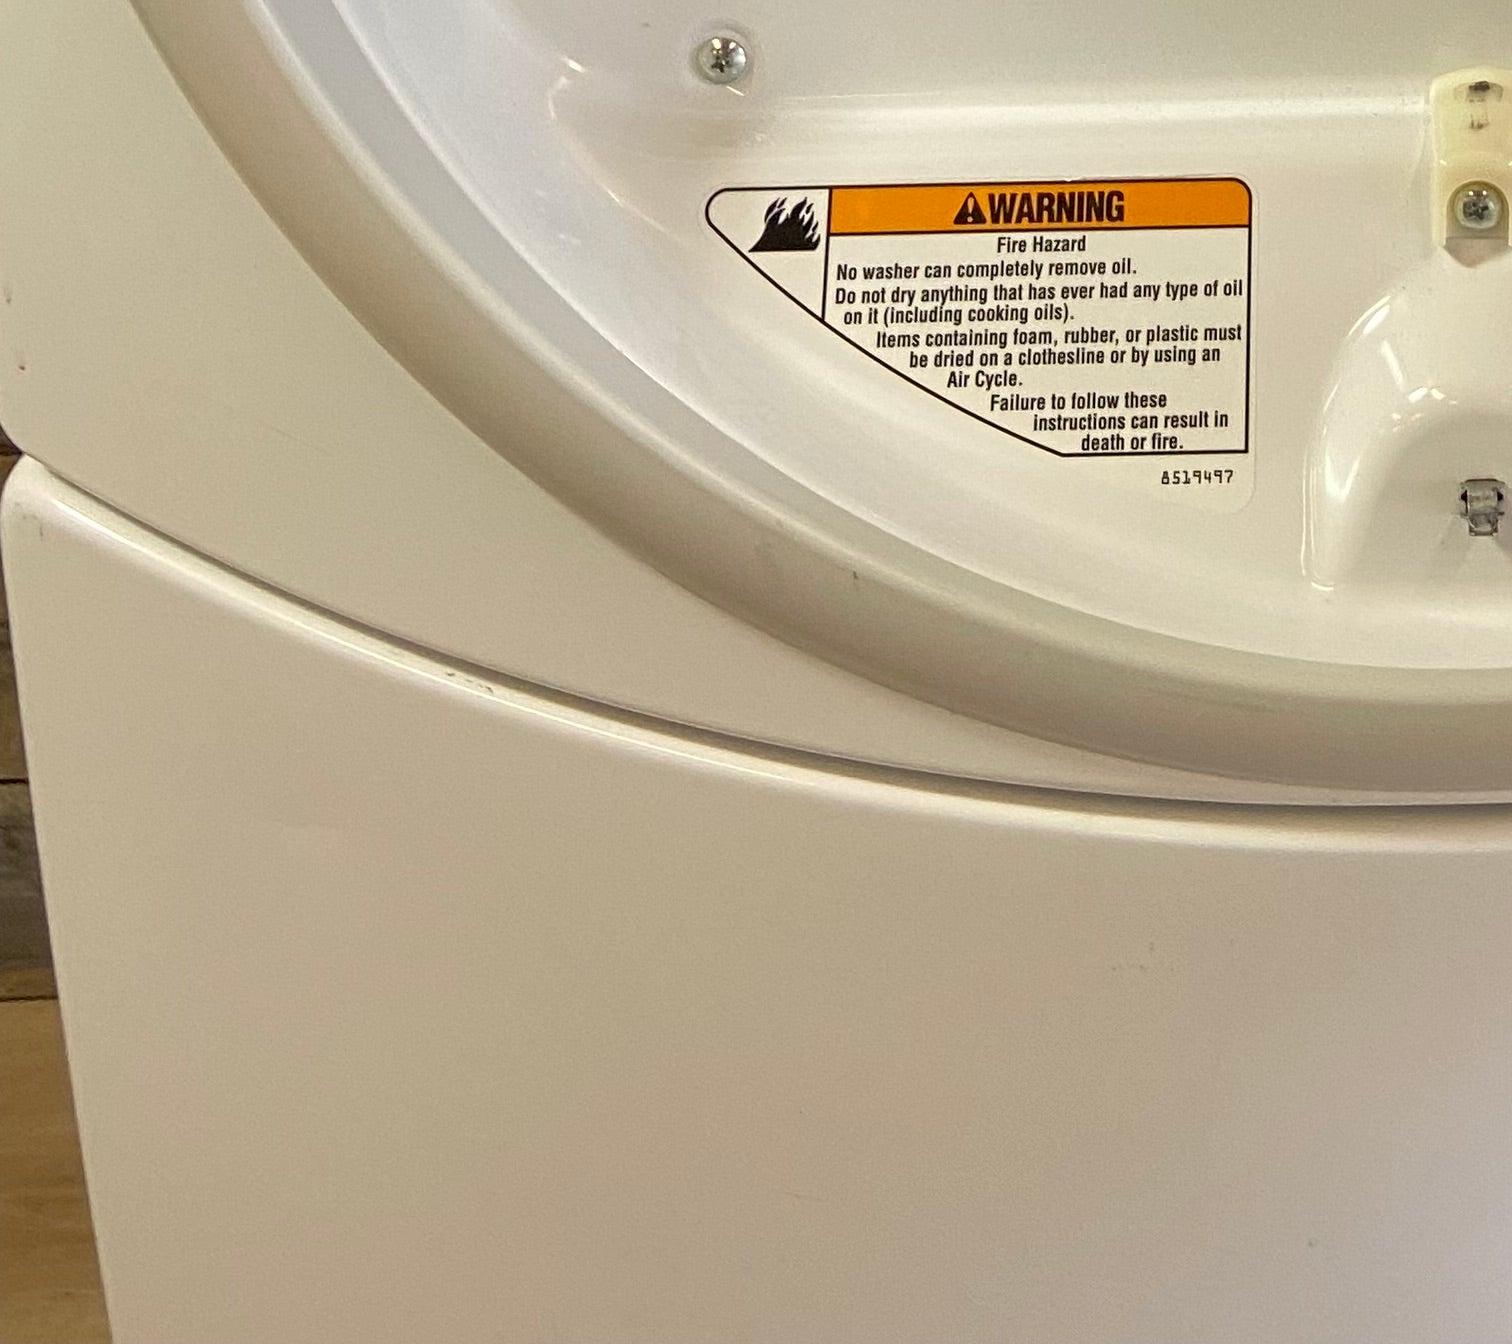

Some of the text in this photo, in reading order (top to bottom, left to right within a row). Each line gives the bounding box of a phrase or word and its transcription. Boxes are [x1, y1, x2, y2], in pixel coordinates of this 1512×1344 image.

[987, 190, 1125, 225] WARNING
[997, 235, 1086, 253] Fire Hazard
[837, 258, 1136, 281] No washer can completely remove oil.
[835, 279, 1242, 307] Do not dry anything that has ever had any type of oil
[844, 303, 1074, 328] on it (including cooking oils).
[1082, 433, 1183, 451] death or fire.
[1161, 470, 1233, 484] 8519497
